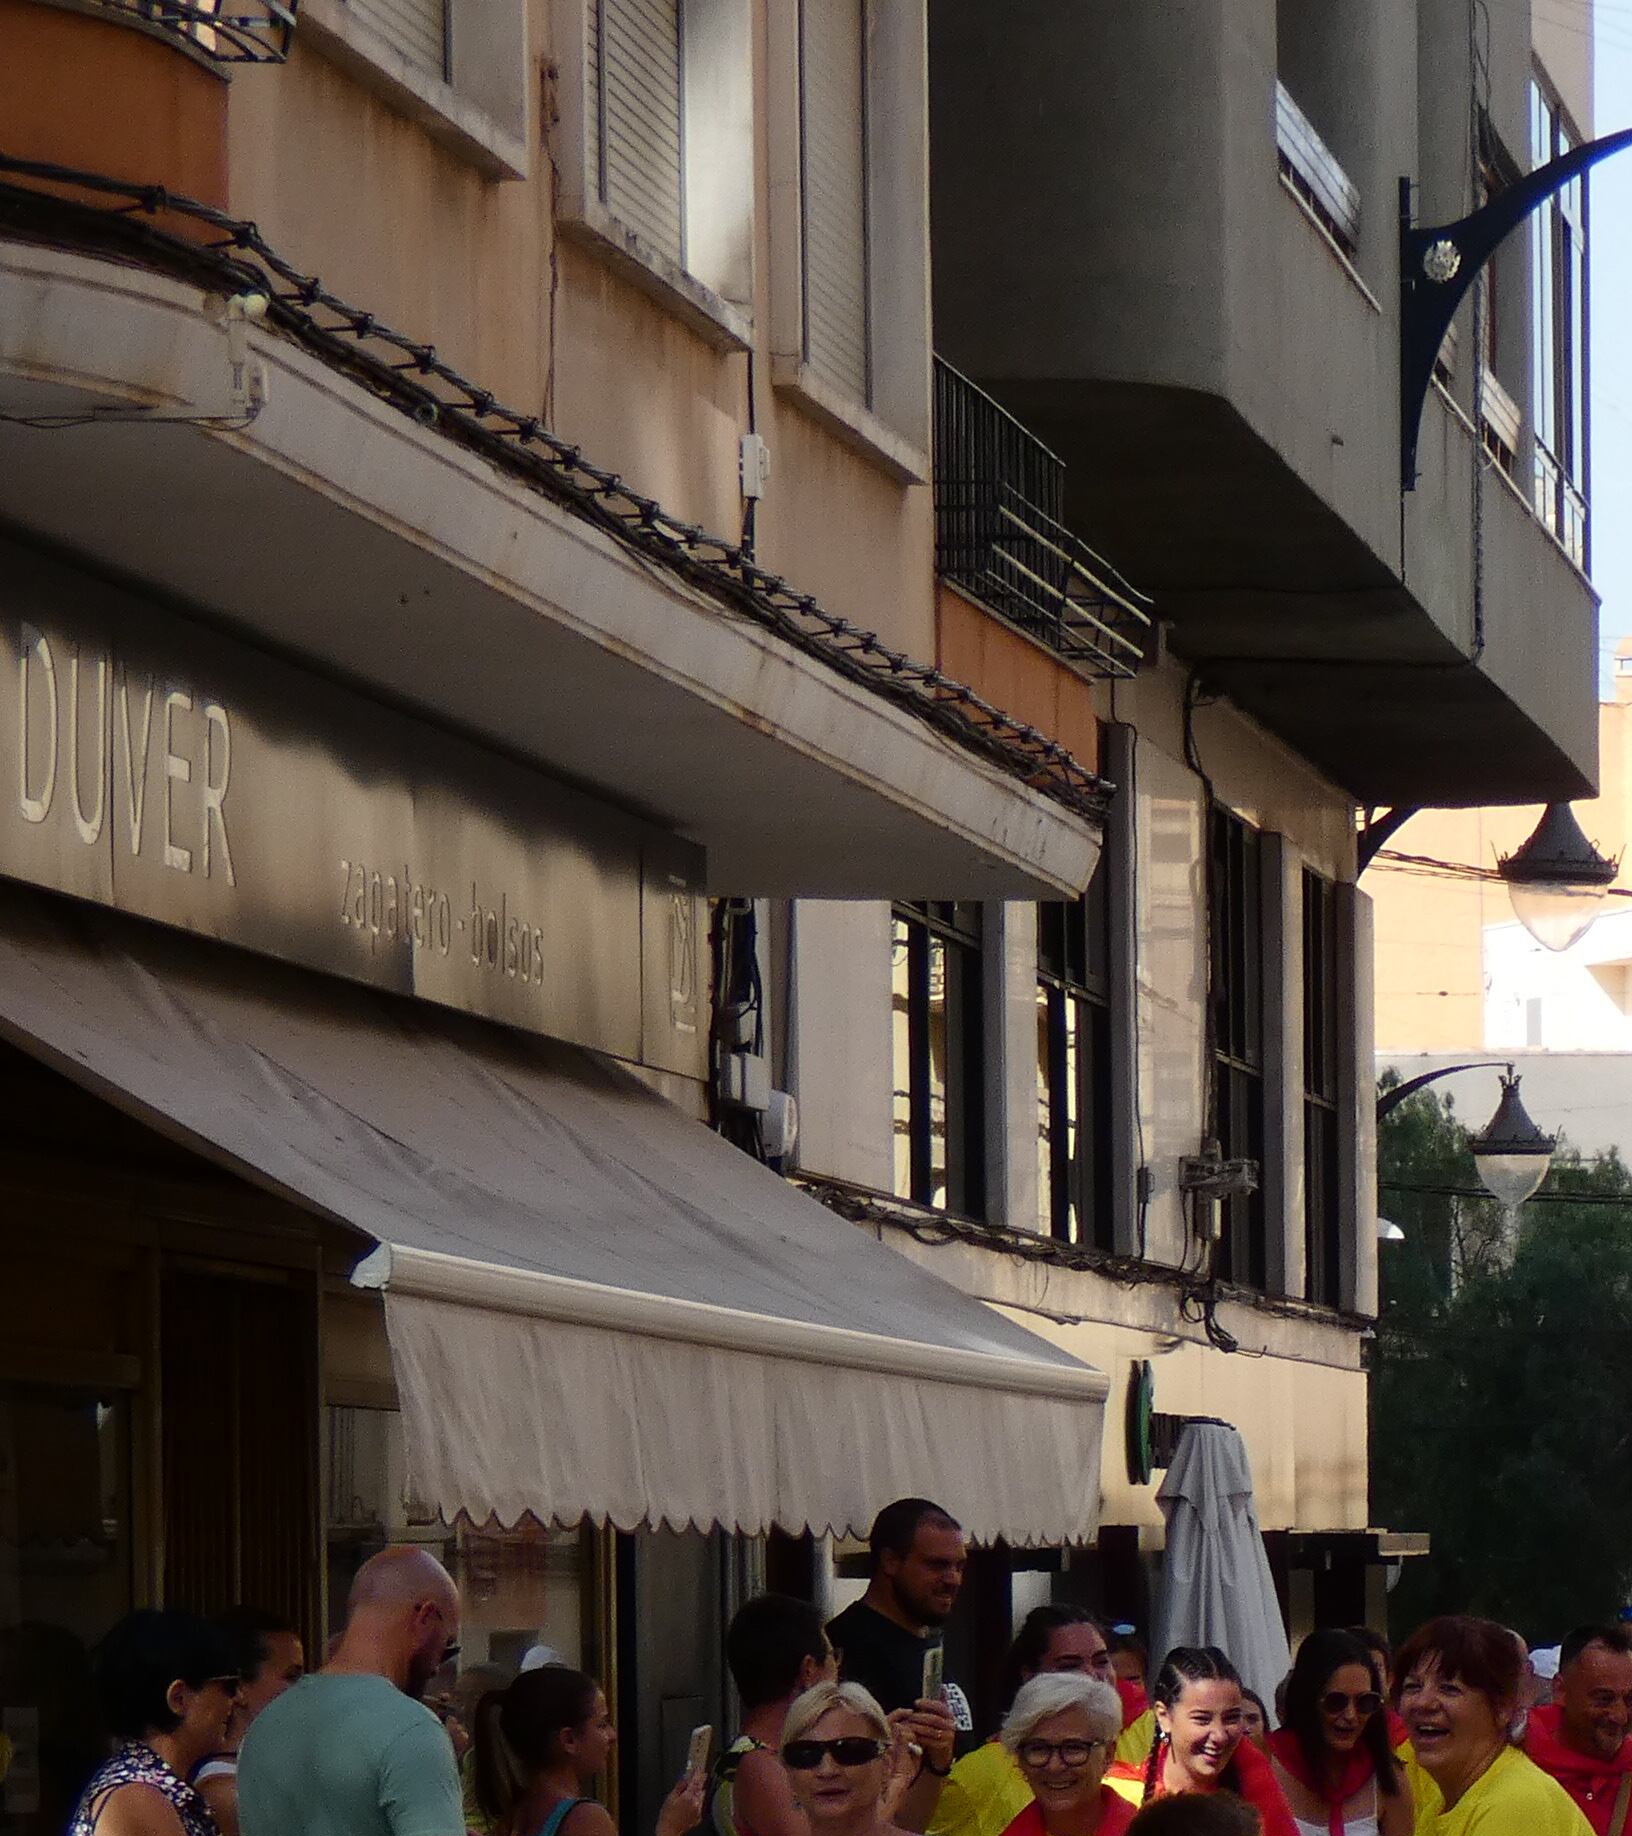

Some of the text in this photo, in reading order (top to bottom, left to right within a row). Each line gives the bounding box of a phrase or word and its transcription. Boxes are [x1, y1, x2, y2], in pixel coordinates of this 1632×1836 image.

[20, 622, 237, 887] DUVER
[341, 858, 452, 957] zapatero
[472, 880, 545, 987] bolsos
